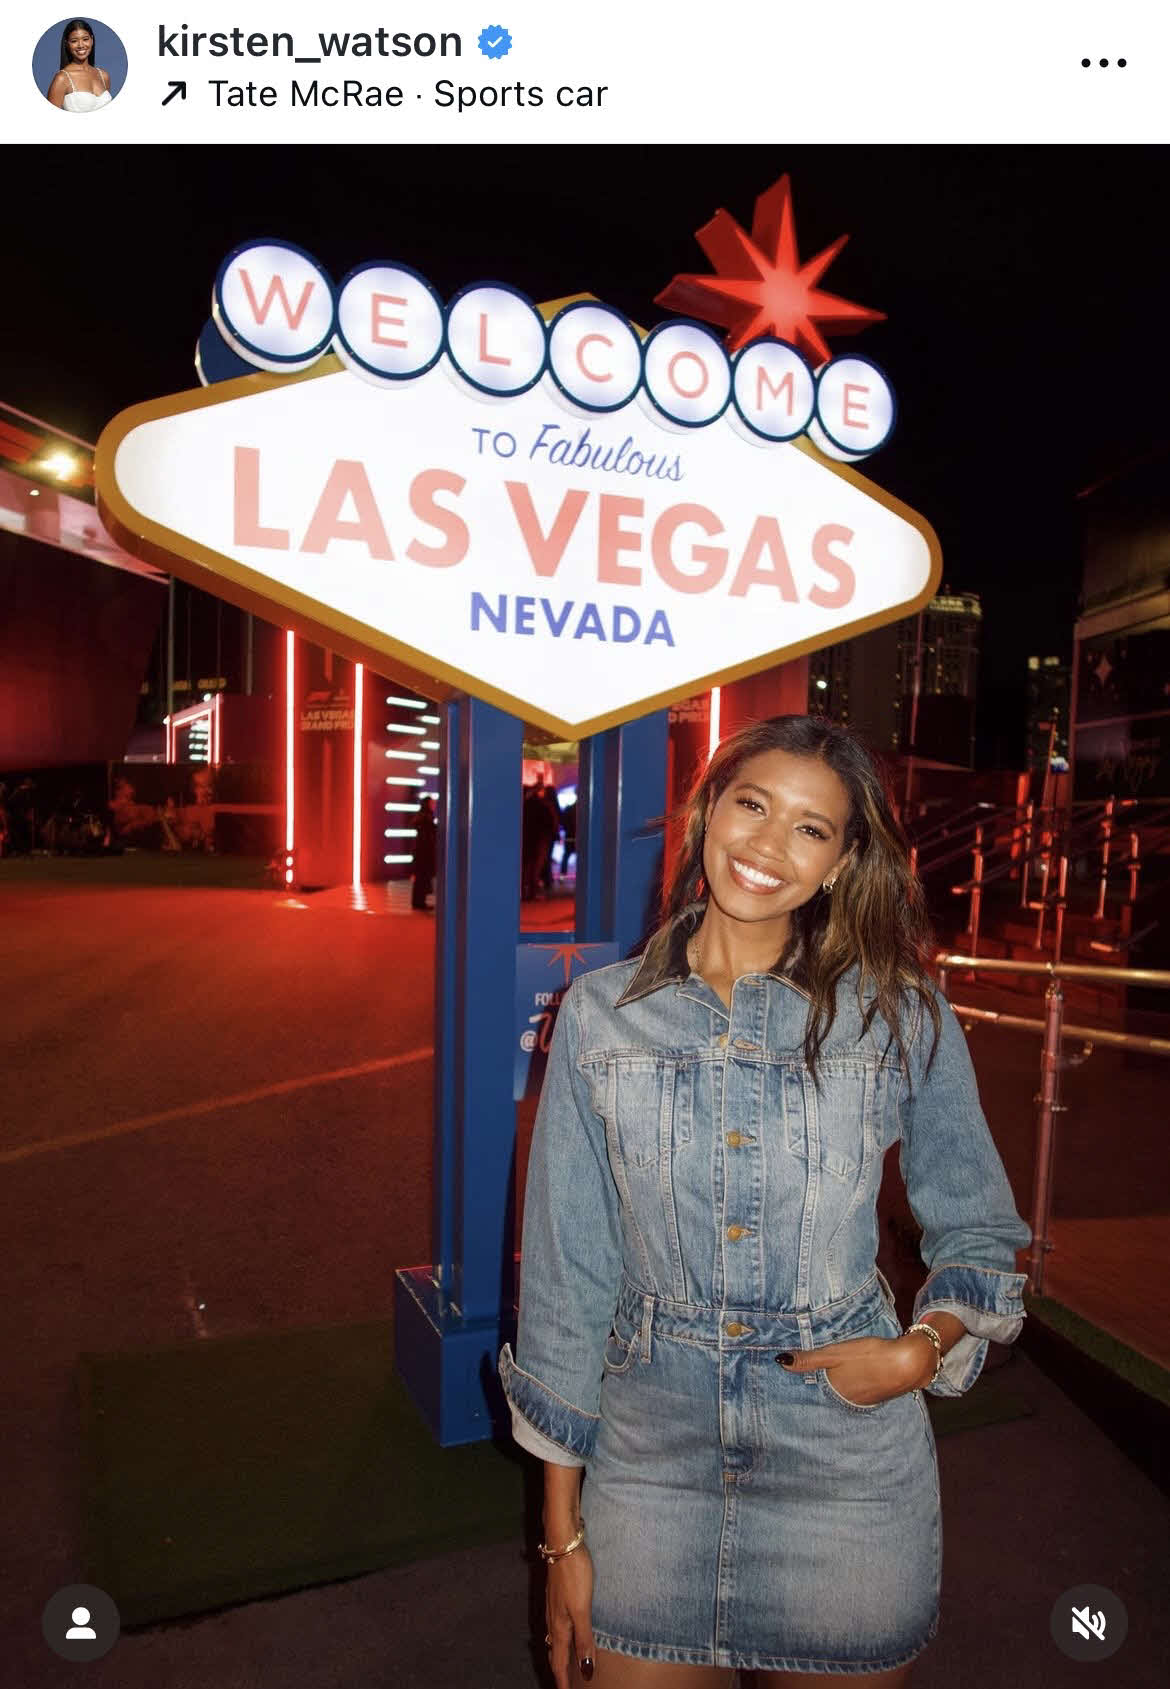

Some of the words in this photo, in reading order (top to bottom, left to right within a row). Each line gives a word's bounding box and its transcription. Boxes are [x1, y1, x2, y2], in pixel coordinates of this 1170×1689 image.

[238, 268, 870, 430] WELCOME
[471, 426, 517, 458] TO
[528, 423, 685, 482] Fabulous
[234, 447, 470, 568] LAS
[504, 480, 857, 611] VEGAS
[470, 591, 677, 648] NEVADA
